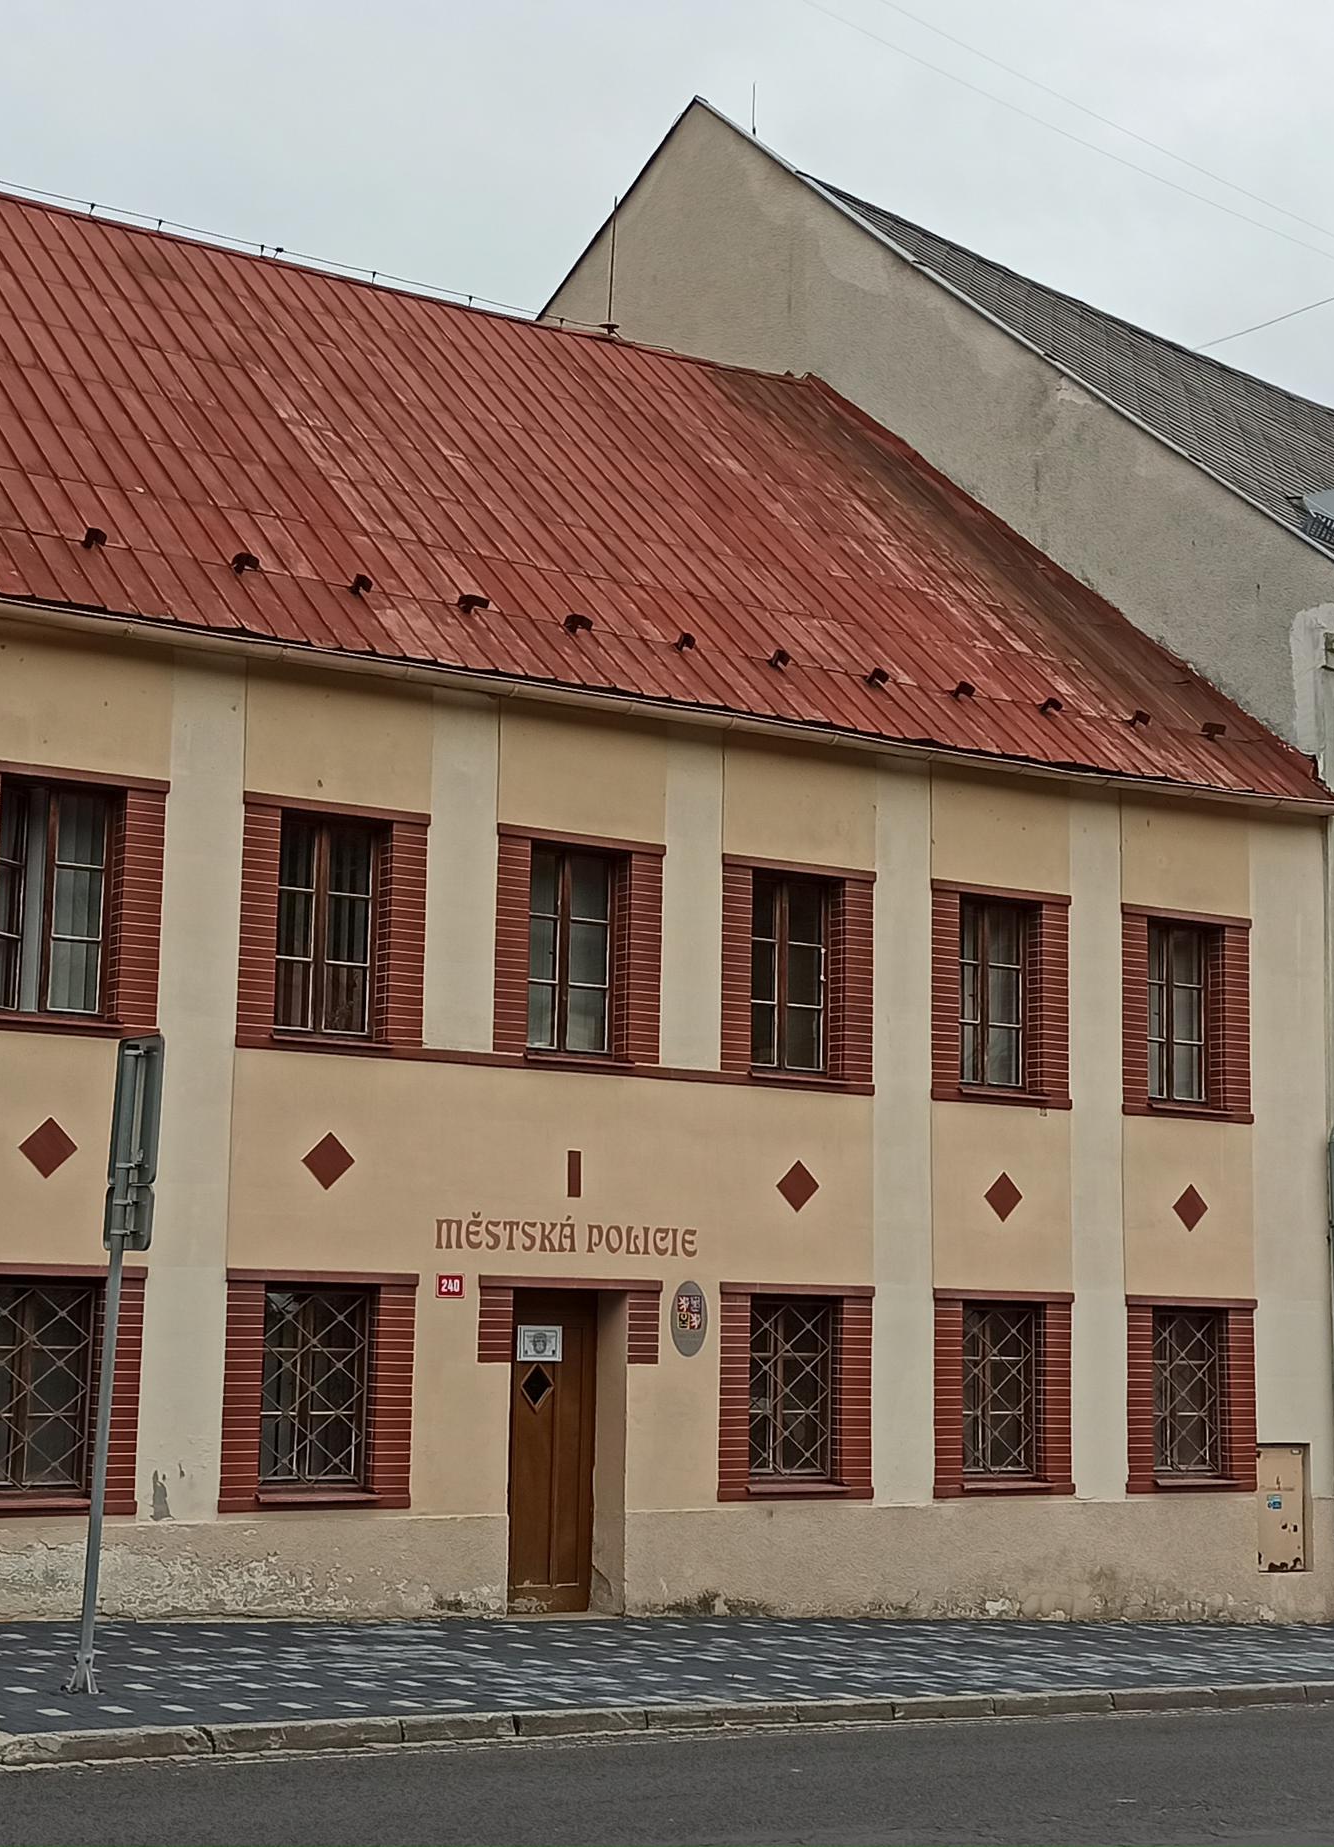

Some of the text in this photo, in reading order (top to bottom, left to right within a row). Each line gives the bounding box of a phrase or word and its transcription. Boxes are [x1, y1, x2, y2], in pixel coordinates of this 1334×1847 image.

[435, 1211, 698, 1258] MĚSTSKÁ POLICIE
[441, 1278, 460, 1292] 240
